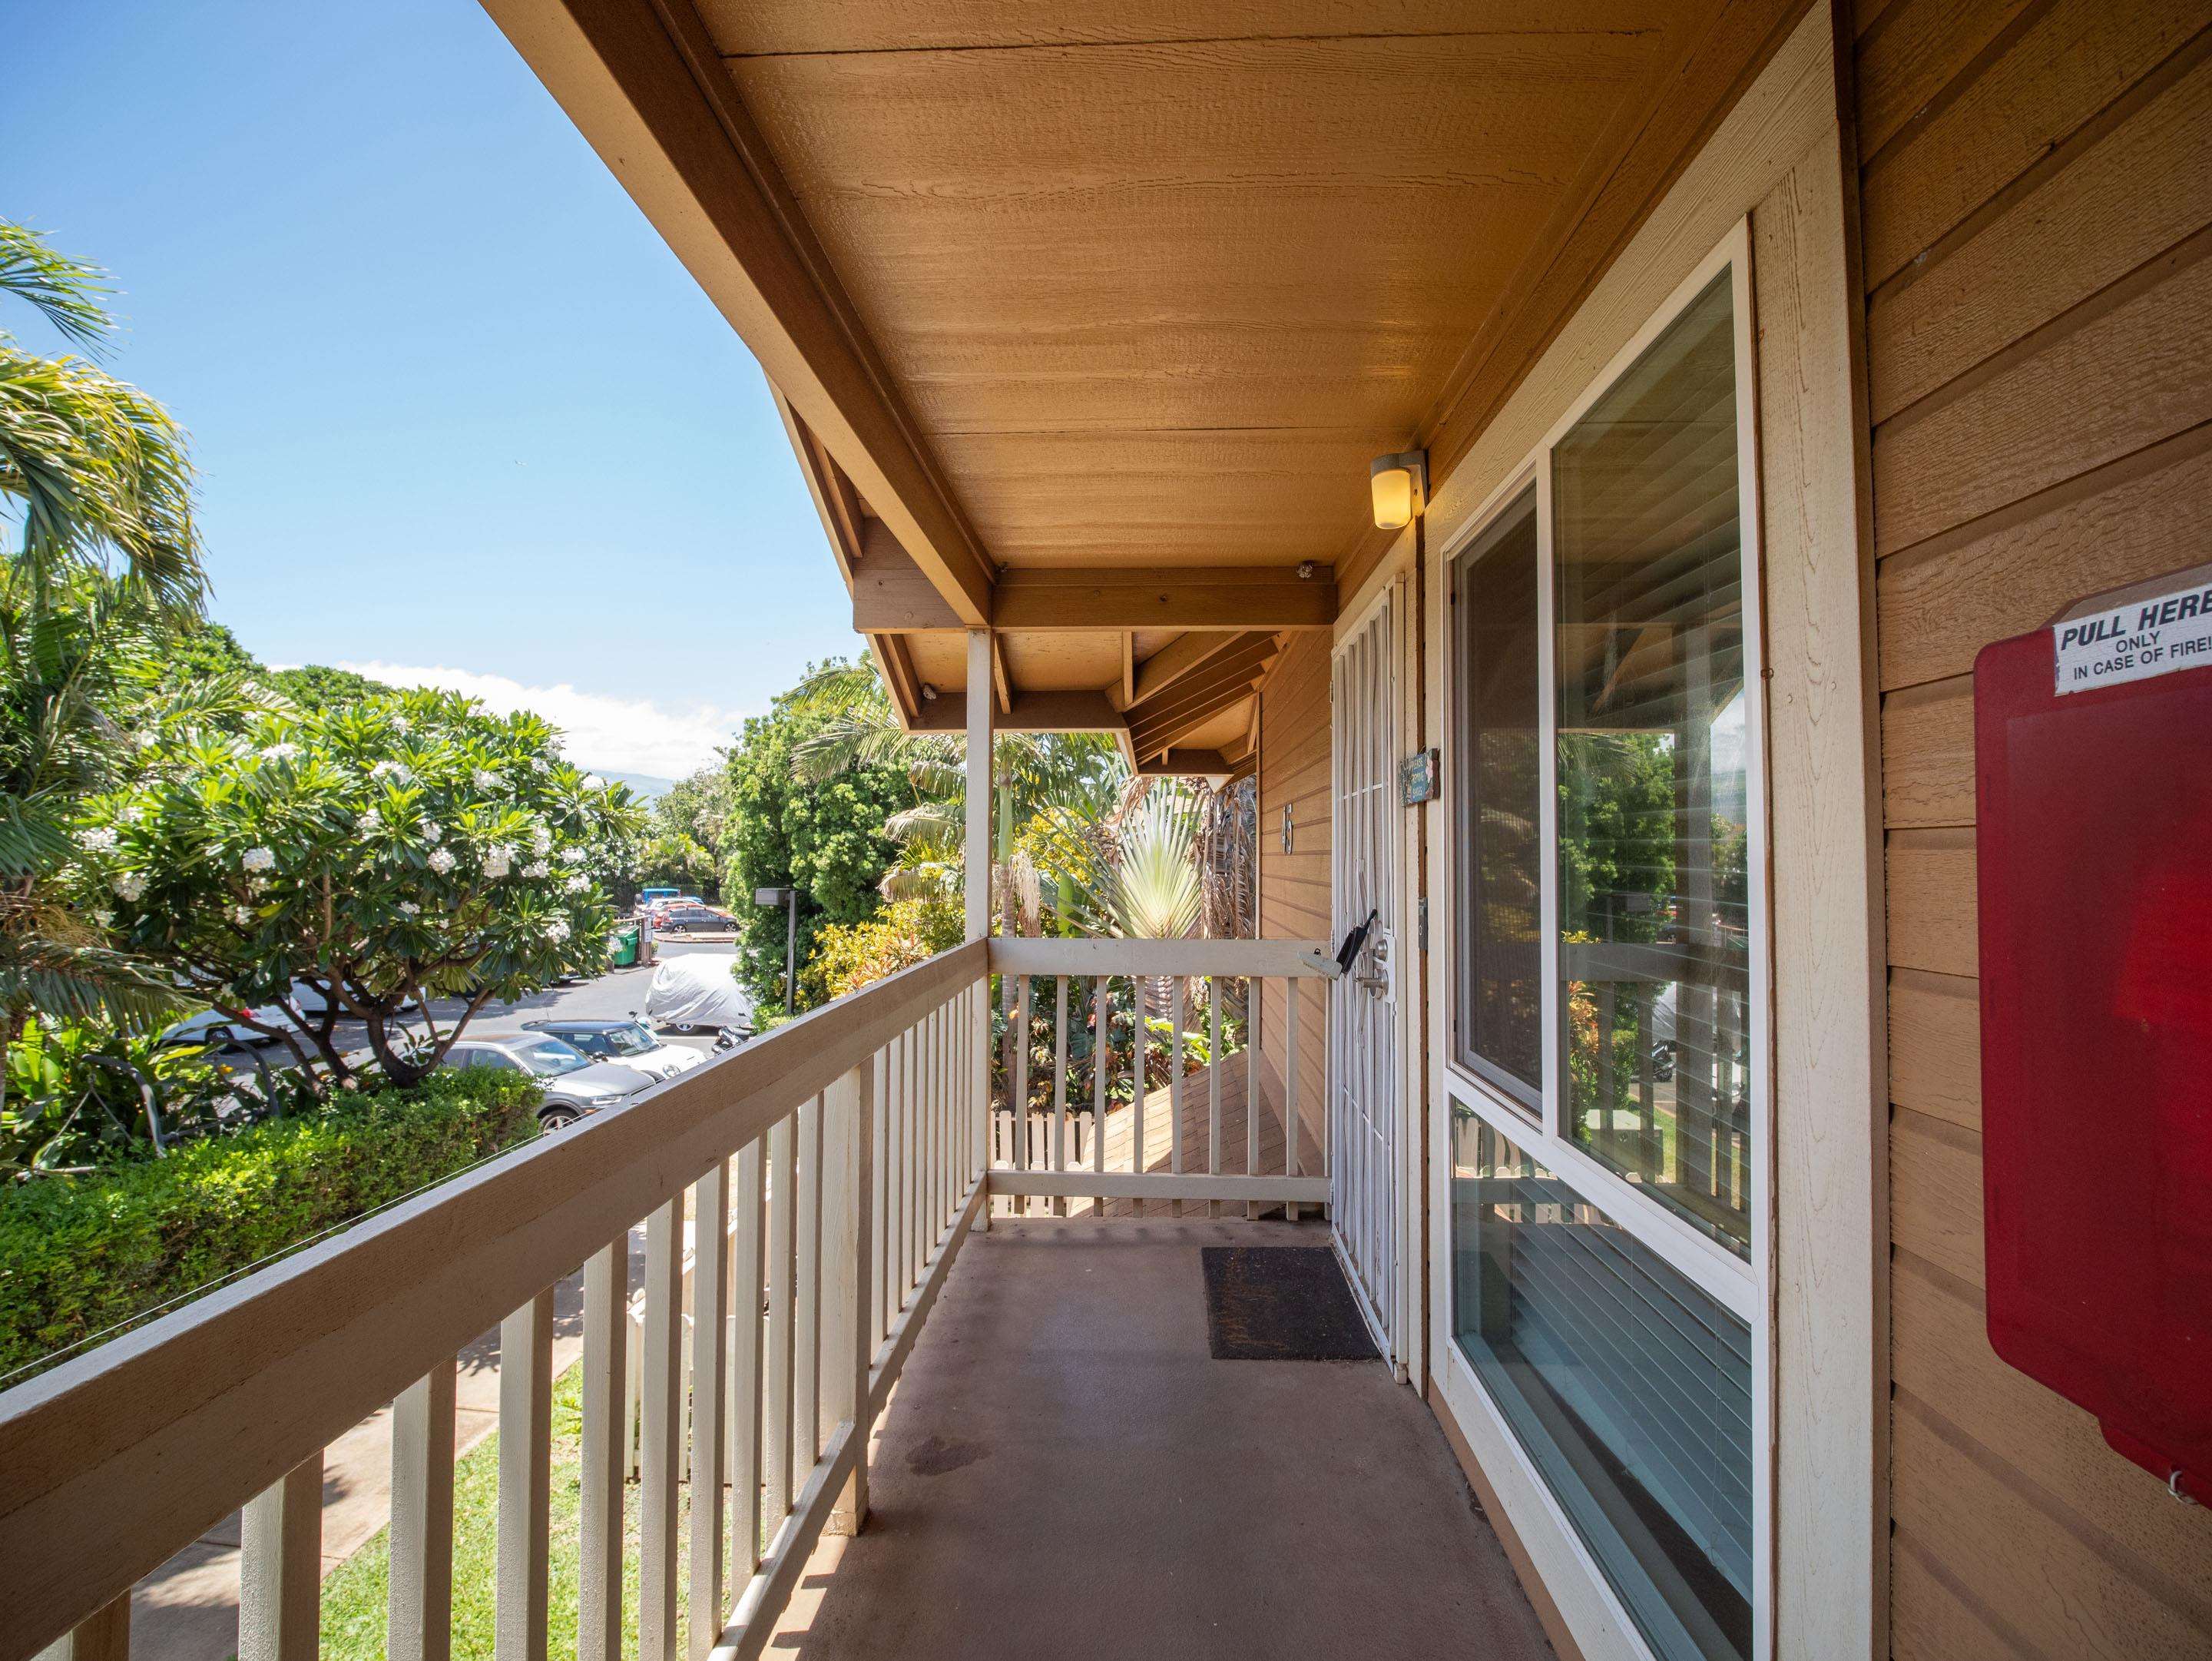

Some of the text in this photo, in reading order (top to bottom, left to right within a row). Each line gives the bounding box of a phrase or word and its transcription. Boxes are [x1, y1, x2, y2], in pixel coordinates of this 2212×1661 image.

[2061, 589, 2212, 651] PULL HERE
[2116, 631, 2161, 653] ONLY
[2074, 635, 2212, 680] IN CASE OF FIRE!
